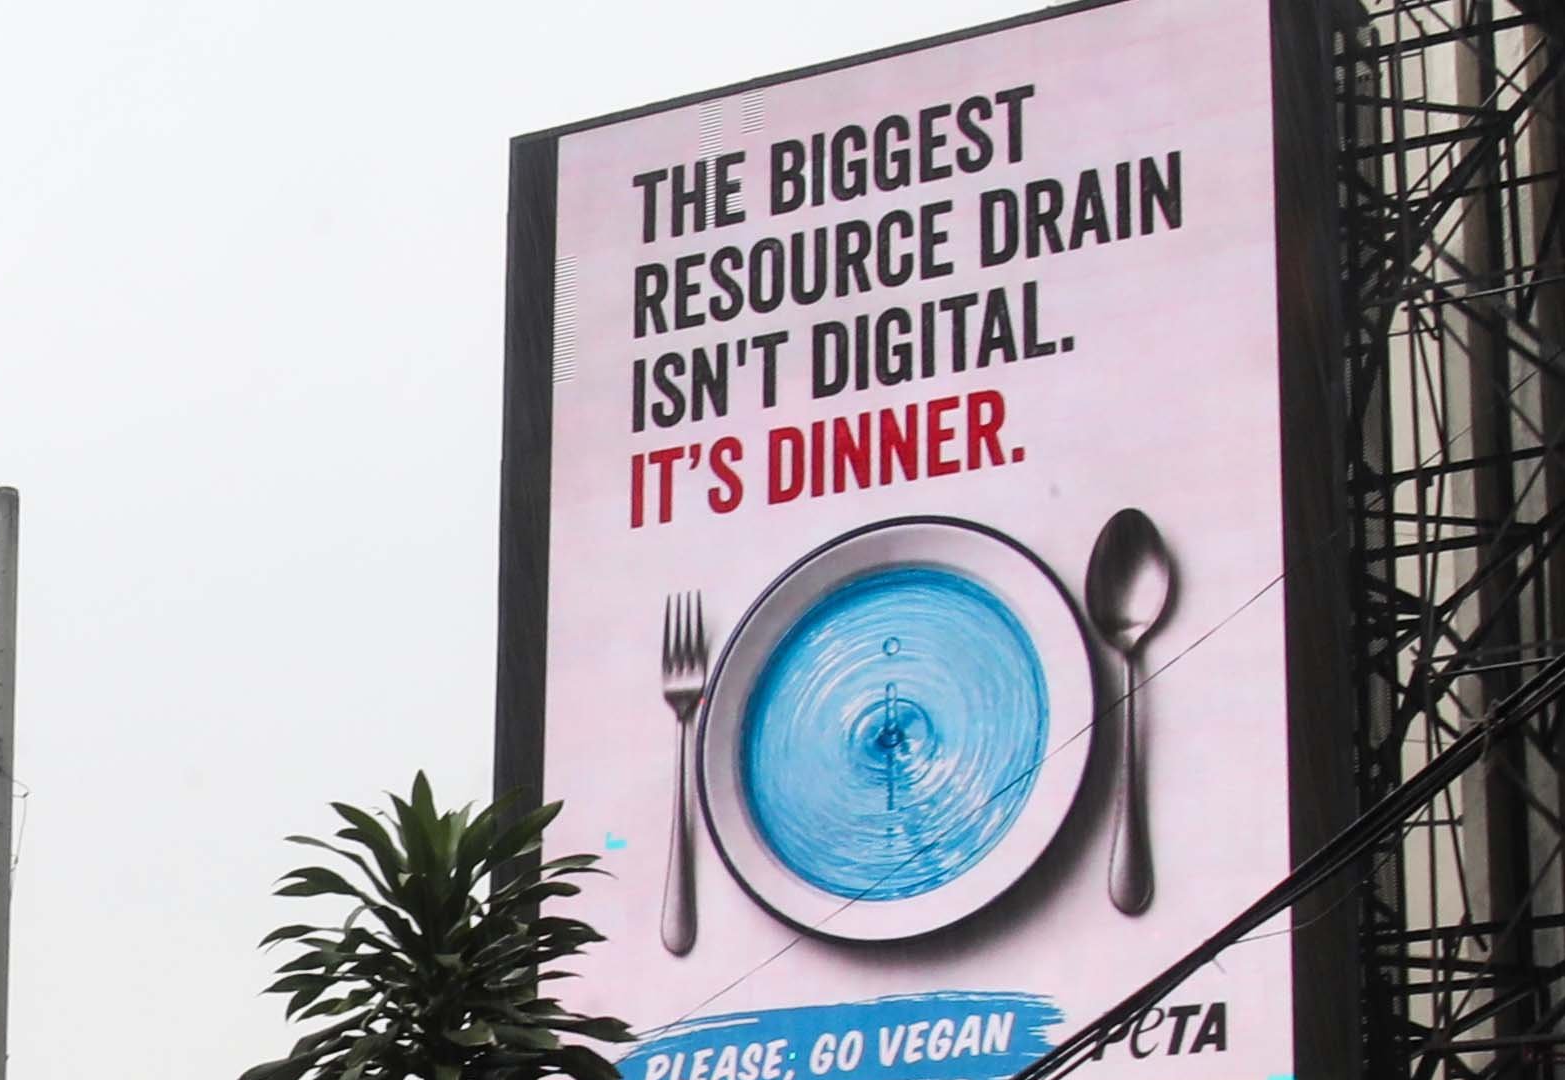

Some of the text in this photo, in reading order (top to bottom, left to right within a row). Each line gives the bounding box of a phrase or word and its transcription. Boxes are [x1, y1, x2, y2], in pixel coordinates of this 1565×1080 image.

[633, 84, 1036, 243] THE BIGGEST
[633, 150, 1183, 339] RESOURCE DRAIN
[631, 281, 1075, 433] ISN'T DIGITAL.
[767, 389, 1025, 505] DINNER.
[810, 1030, 864, 1076] GO
[878, 1011, 1015, 1067] VEGAN
